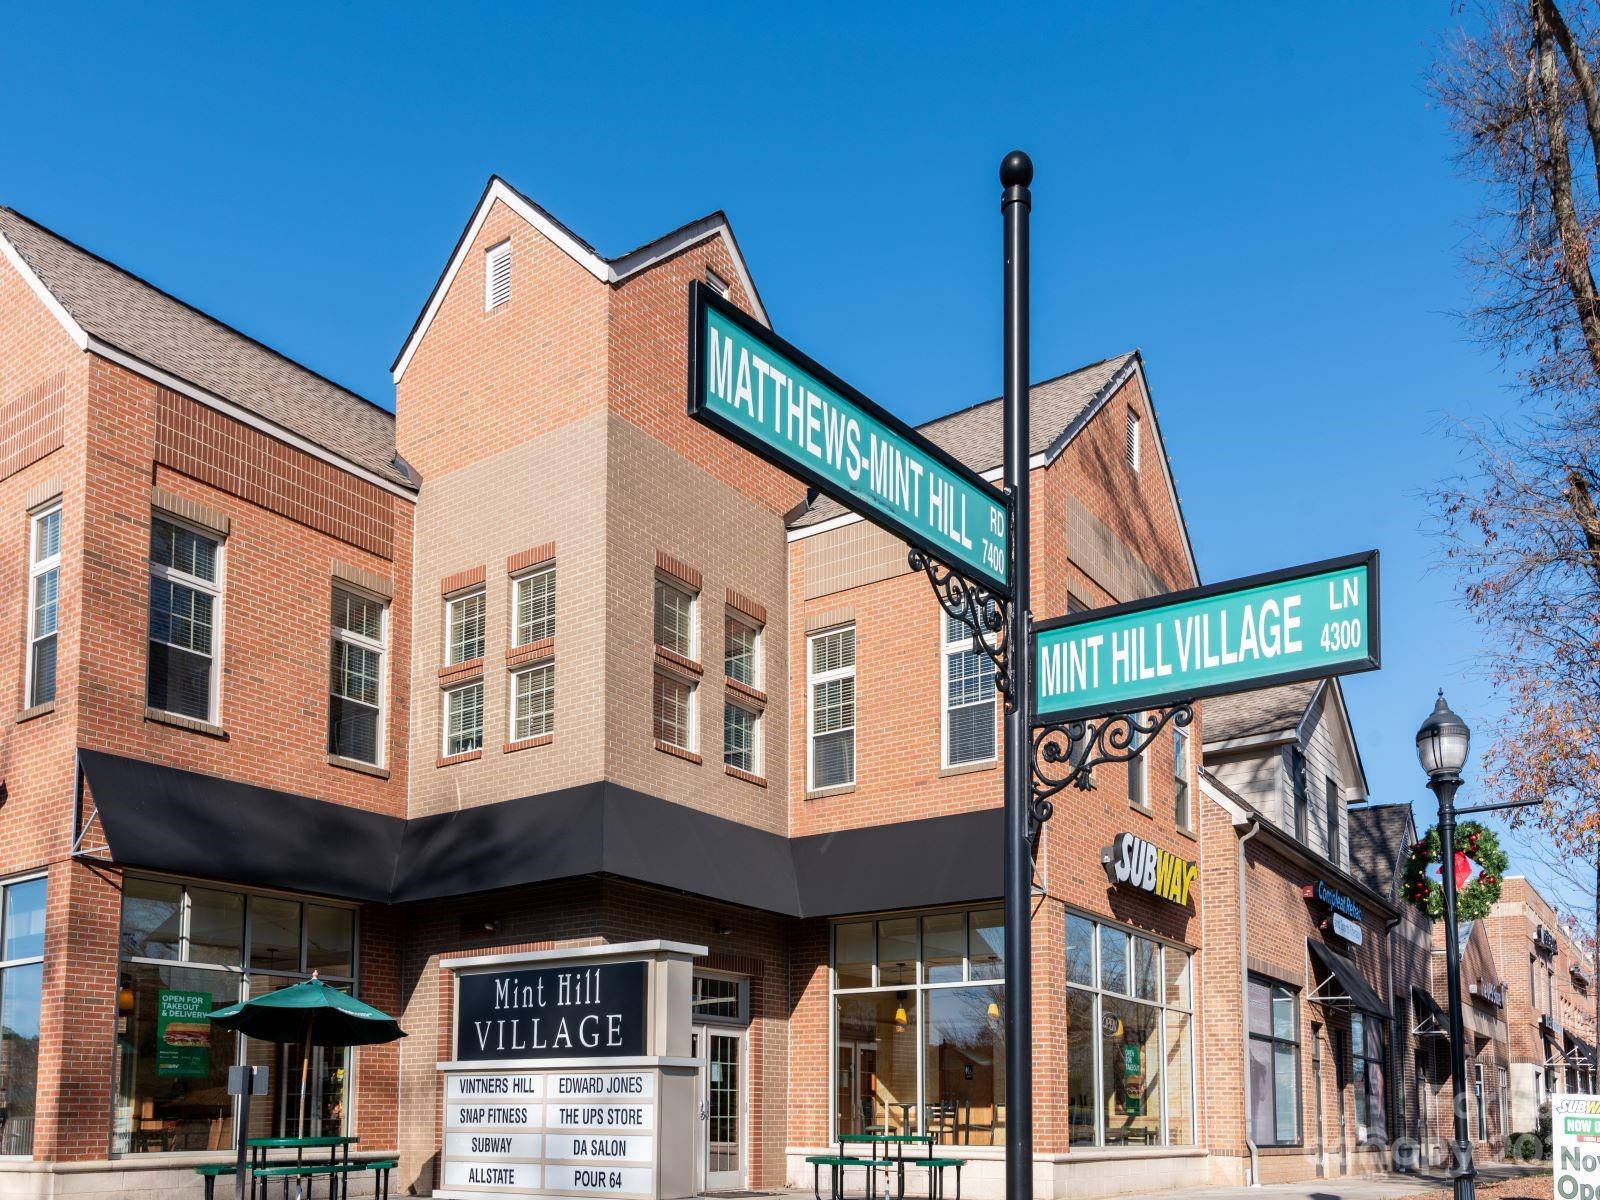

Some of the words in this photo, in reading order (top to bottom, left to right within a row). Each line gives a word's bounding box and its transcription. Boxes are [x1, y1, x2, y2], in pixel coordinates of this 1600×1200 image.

[710, 326, 923, 518] MATTHEWS-MINT
[929, 472, 972, 550] HILL
[990, 506, 1004, 538] RD
[982, 538, 1005, 575] 7400
[1329, 576, 1359, 611] LN
[1320, 619, 1362, 652] 4300
[1041, 634, 1104, 697] MINT
[1111, 622, 1173, 685] HILL
[1174, 594, 1302, 673] VILLAGE
[1114, 832, 1198, 907] SUBWAY
[494, 976, 547, 1010] Mint
[557, 968, 601, 1006] Hill
[161, 1002, 200, 1011] TAKEOUT
[162, 995, 185, 1003] OPEN
[186, 996, 204, 1004] FOR
[169, 1010, 208, 1019] DELIVERY
[474, 1014, 623, 1051] VILLAGE
[459, 1078, 509, 1094] VINTNERS
[513, 1077, 535, 1094] HILL
[559, 1077, 604, 1094] EDWARD
[606, 1076, 643, 1094] JONES
[1557, 1099, 1600, 1114] SUBW
[460, 1108, 485, 1124] SNAP
[487, 1108, 528, 1124] FITNESS
[559, 1108, 579, 1124] THE
[582, 1108, 604, 1125] UPS
[607, 1108, 643, 1125] STORE
[1567, 1119, 1591, 1132] NOW
[471, 1137, 513, 1153] SUBWAY
[573, 1139, 588, 1155] DA
[591, 1139, 626, 1156] SALON
[1561, 1145, 1600, 1173] No
[468, 1168, 515, 1184] ALLSTATE
[574, 1170, 606, 1188] POUR
[609, 1171, 622, 1188] 64
